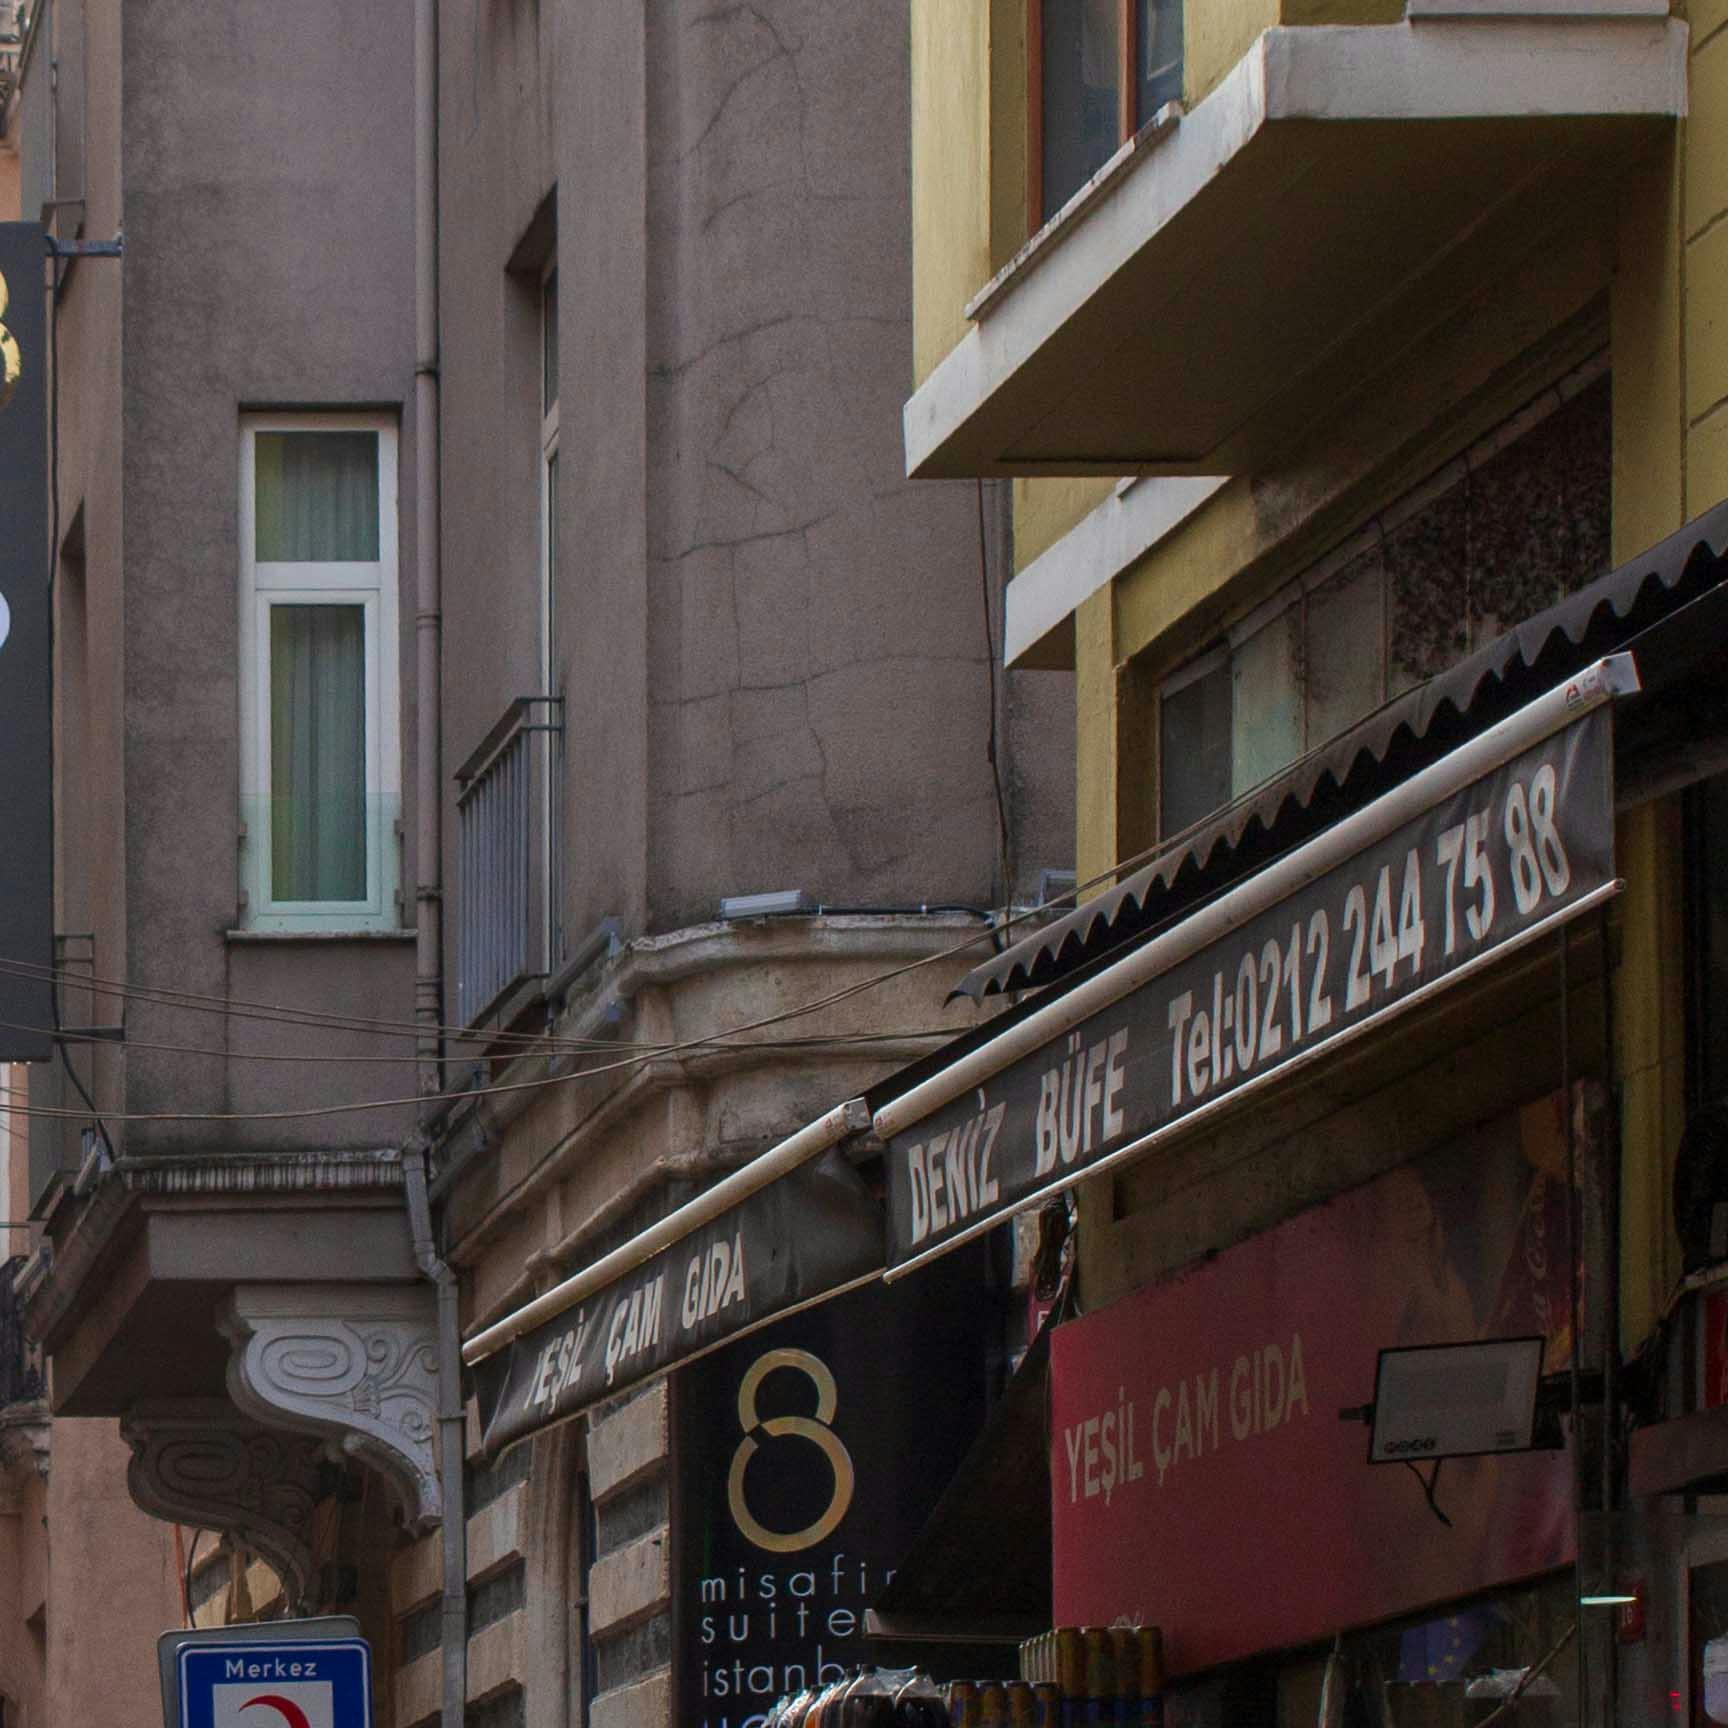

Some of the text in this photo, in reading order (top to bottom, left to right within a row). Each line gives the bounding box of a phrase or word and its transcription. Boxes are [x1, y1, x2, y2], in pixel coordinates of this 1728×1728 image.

[907, 1089, 1007, 1245] DENİZ
[1035, 1026, 1128, 1179] BÜFE
[1343, 849, 1424, 1013] 244
[1437, 807, 1493, 954] 75
[1504, 763, 1571, 915] 88
[605, 1274, 664, 1386] ÇAM
[682, 1232, 744, 1329] GIDA
[1065, 1333, 1312, 1506] YEŞİL ÇAM GIDA
[701, 1554, 896, 1602] misafir
[702, 1602, 855, 1643] suite
[225, 1658, 317, 1679] Merkez
[704, 1645, 846, 1697] istanb
